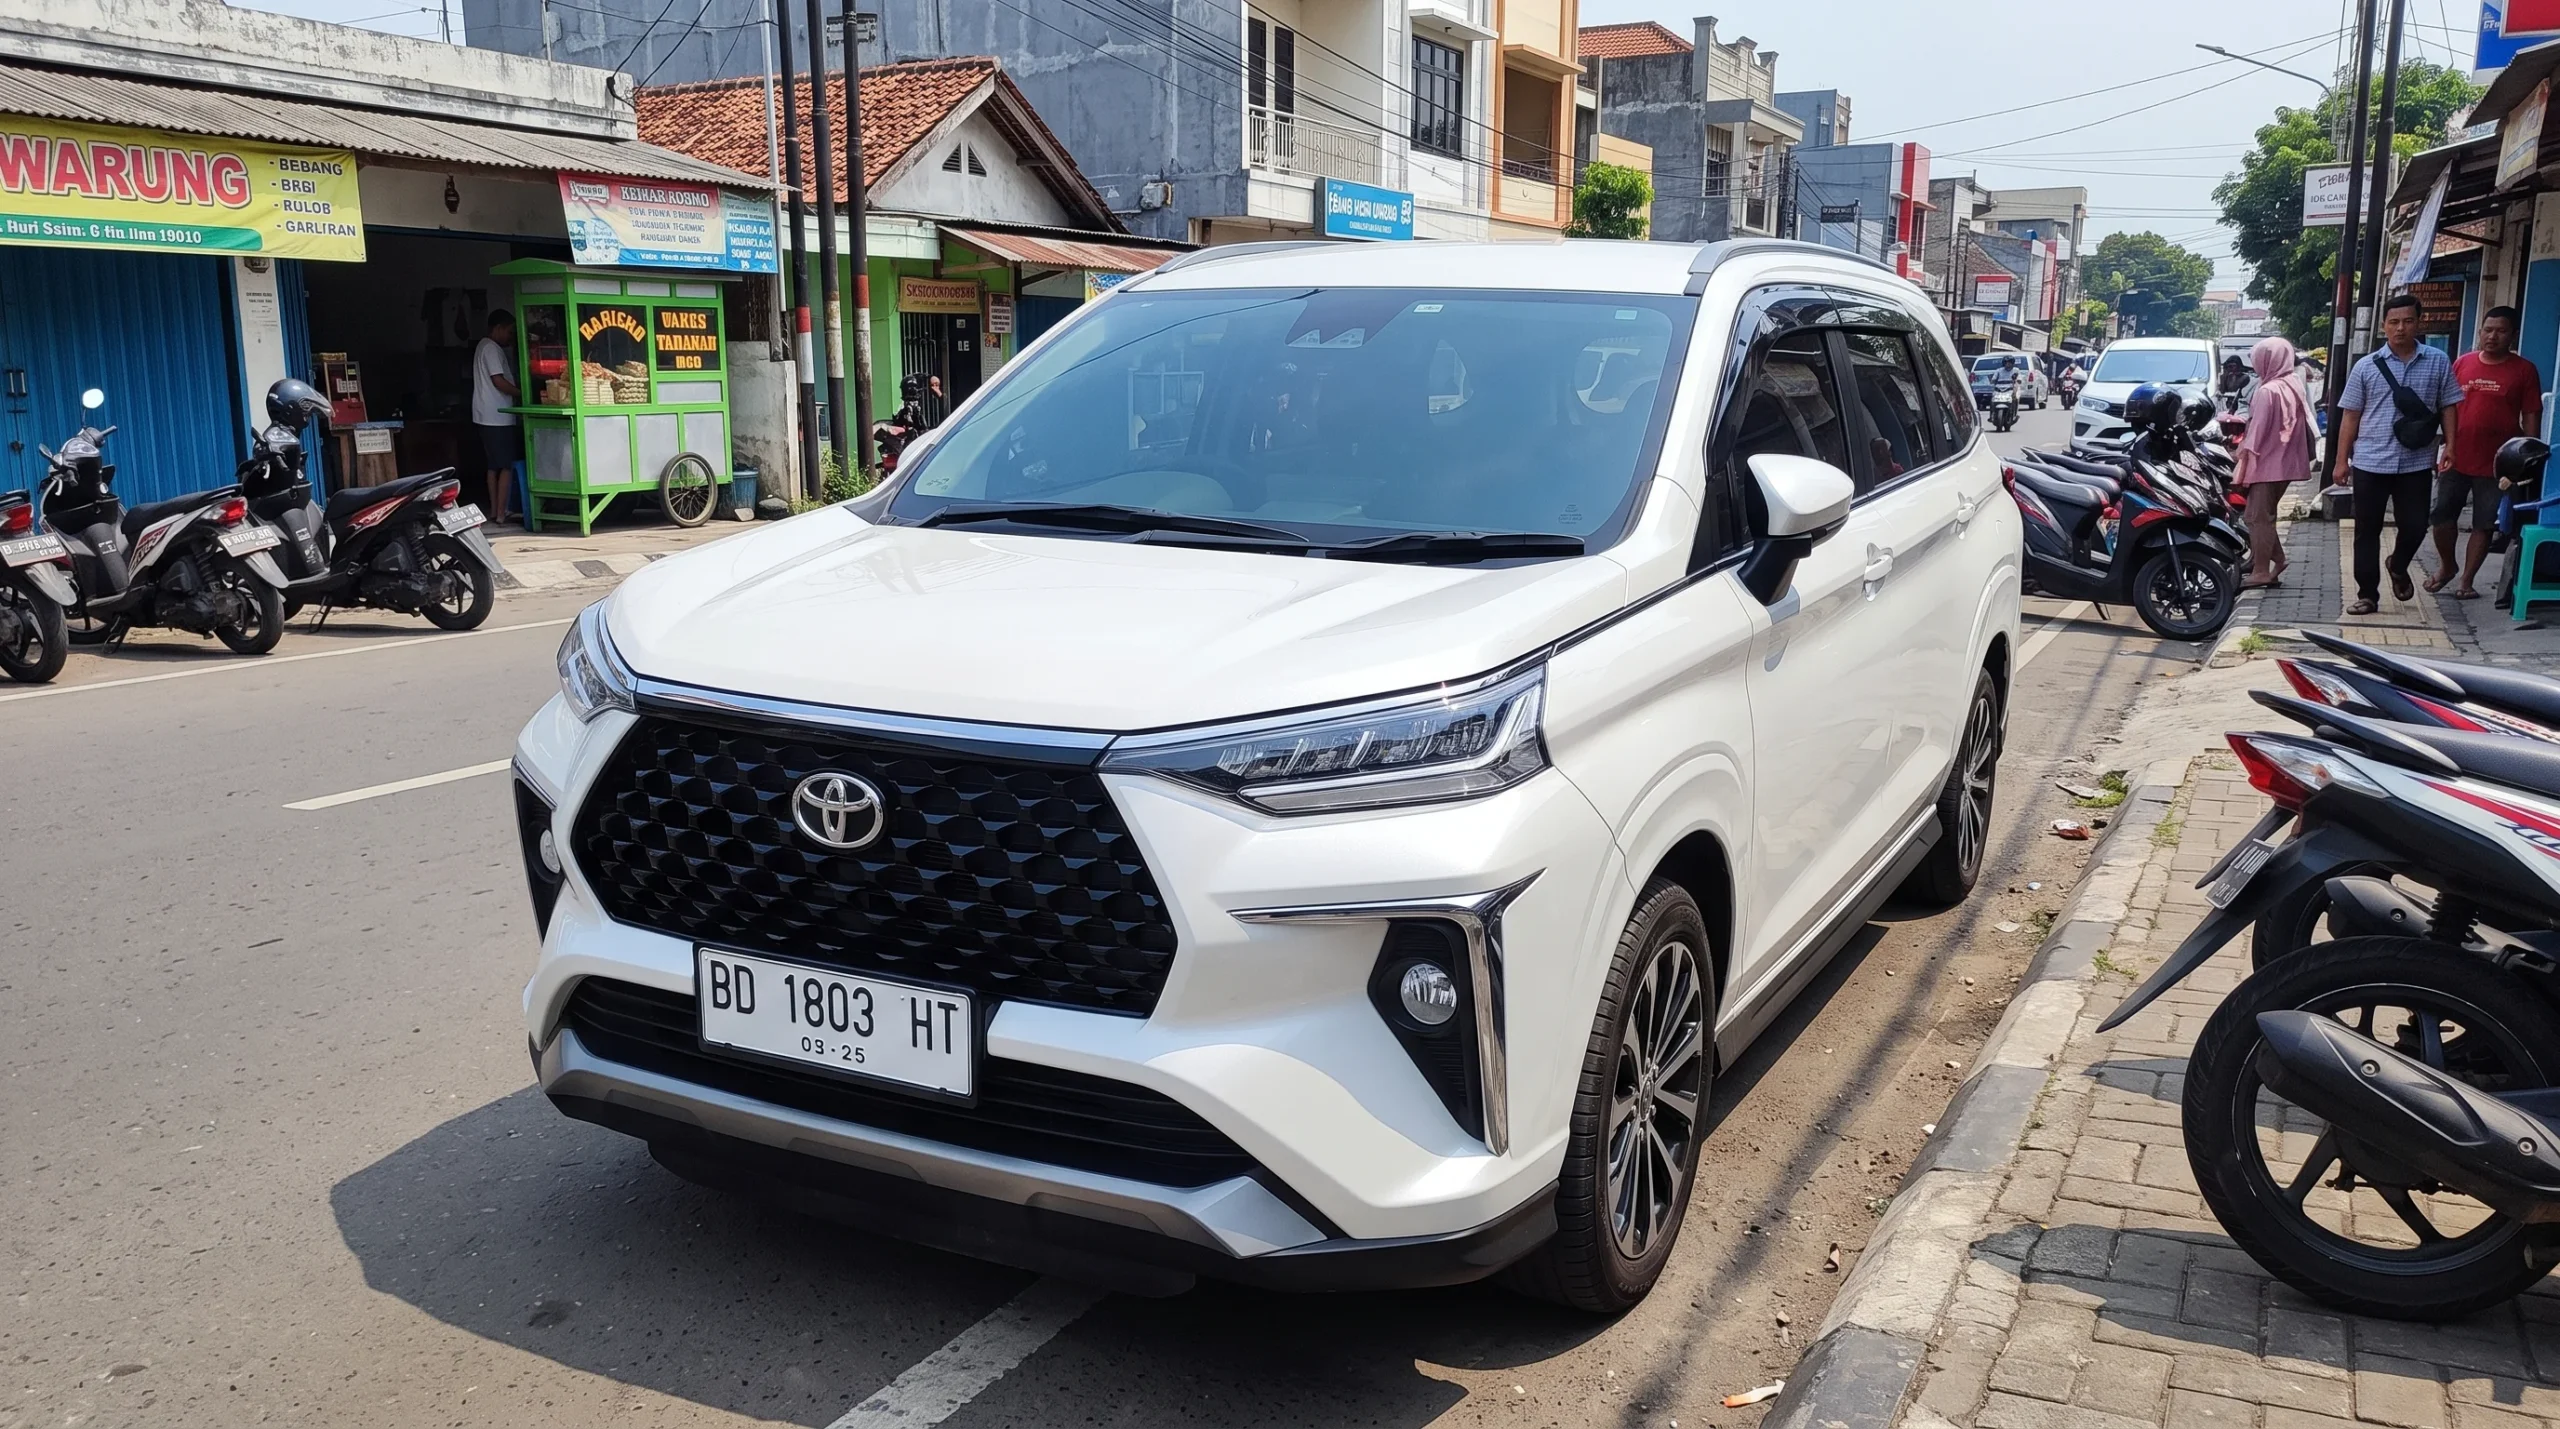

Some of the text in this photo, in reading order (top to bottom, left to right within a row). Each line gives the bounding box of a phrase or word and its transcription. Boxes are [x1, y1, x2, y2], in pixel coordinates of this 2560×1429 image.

[0, 133, 251, 208] WARUNG
[280, 158, 343, 176] BEBANG
[159, 229, 202, 244] 19010
[710, 959, 960, 1055] BD 1803 HT
